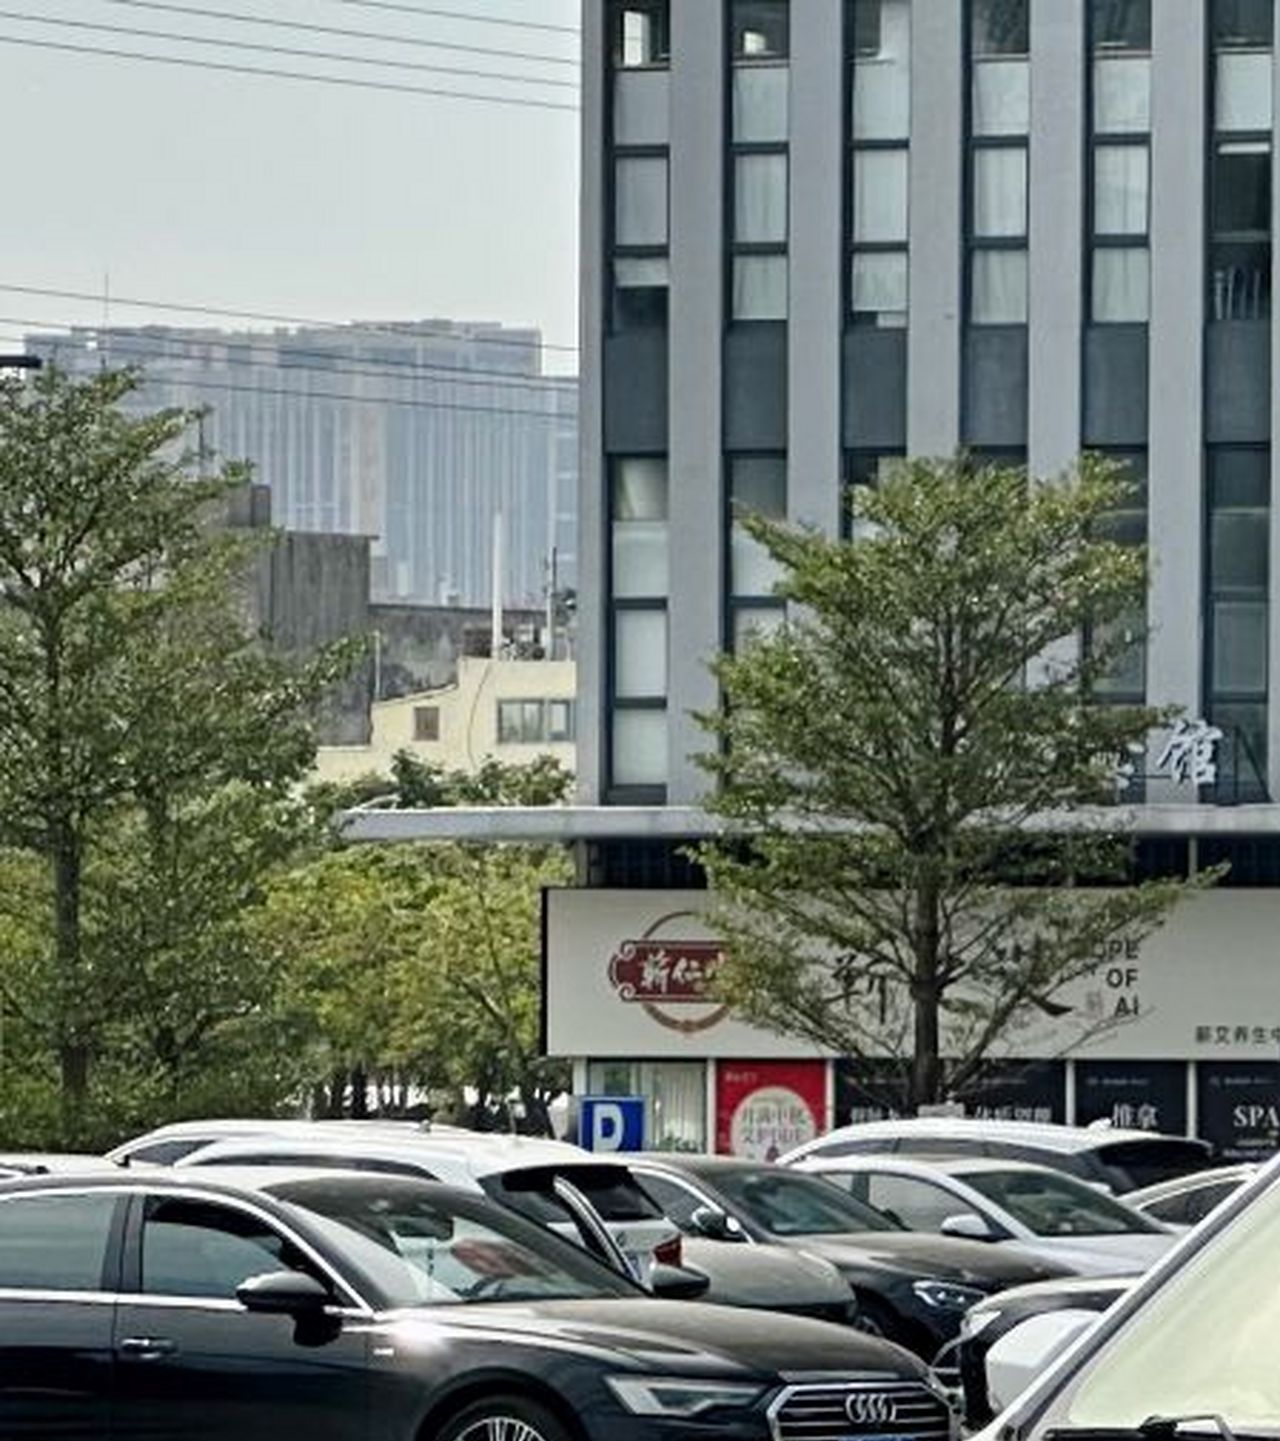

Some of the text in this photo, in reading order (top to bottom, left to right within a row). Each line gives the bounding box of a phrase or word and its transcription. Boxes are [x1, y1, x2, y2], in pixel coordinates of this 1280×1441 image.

[1106, 968, 1138, 988] OF
[1114, 995, 1139, 1016] AI
[1233, 1105, 1280, 1128] SPA
